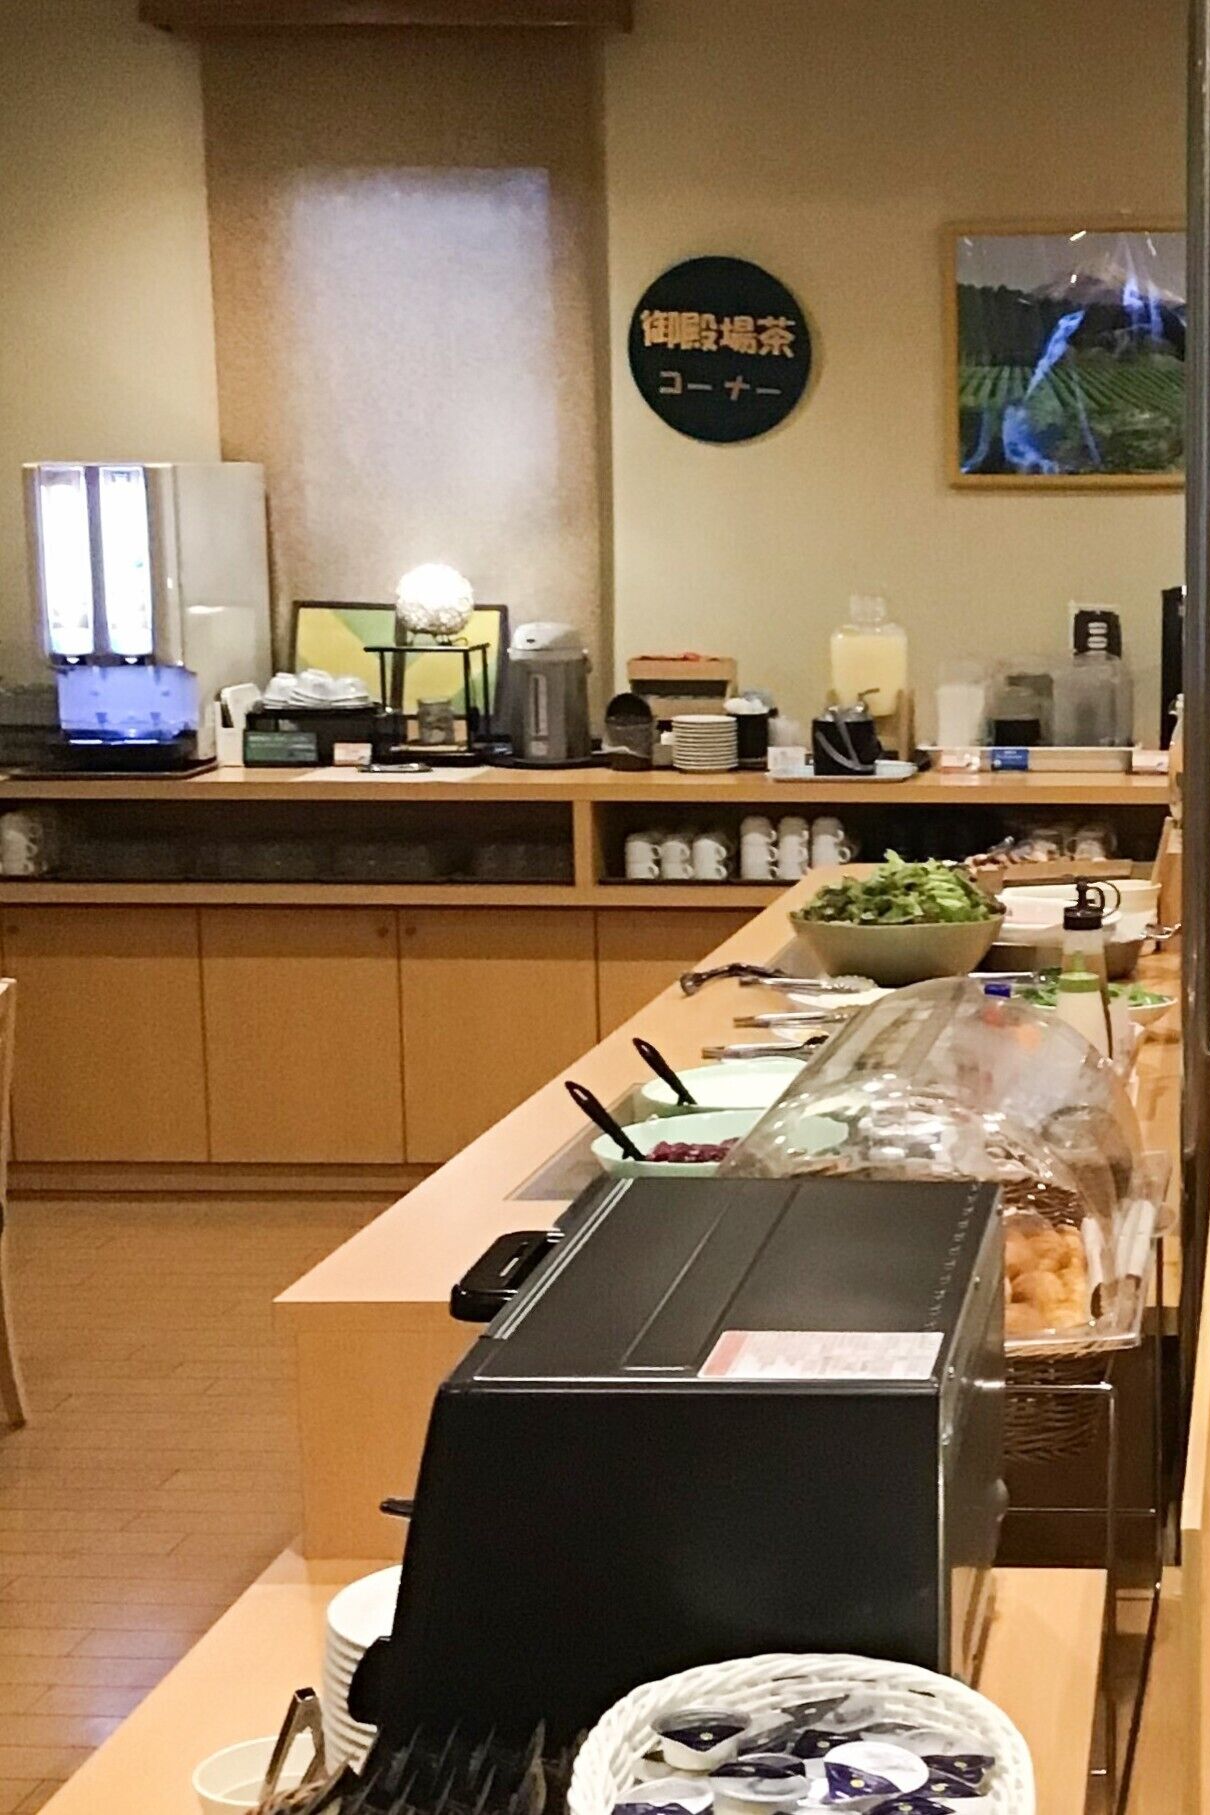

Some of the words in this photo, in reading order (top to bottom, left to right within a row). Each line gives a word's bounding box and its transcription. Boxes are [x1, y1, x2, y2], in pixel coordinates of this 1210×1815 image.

[640, 310, 796, 358] 御殿場茶
[658, 370, 783, 401] コーナー
